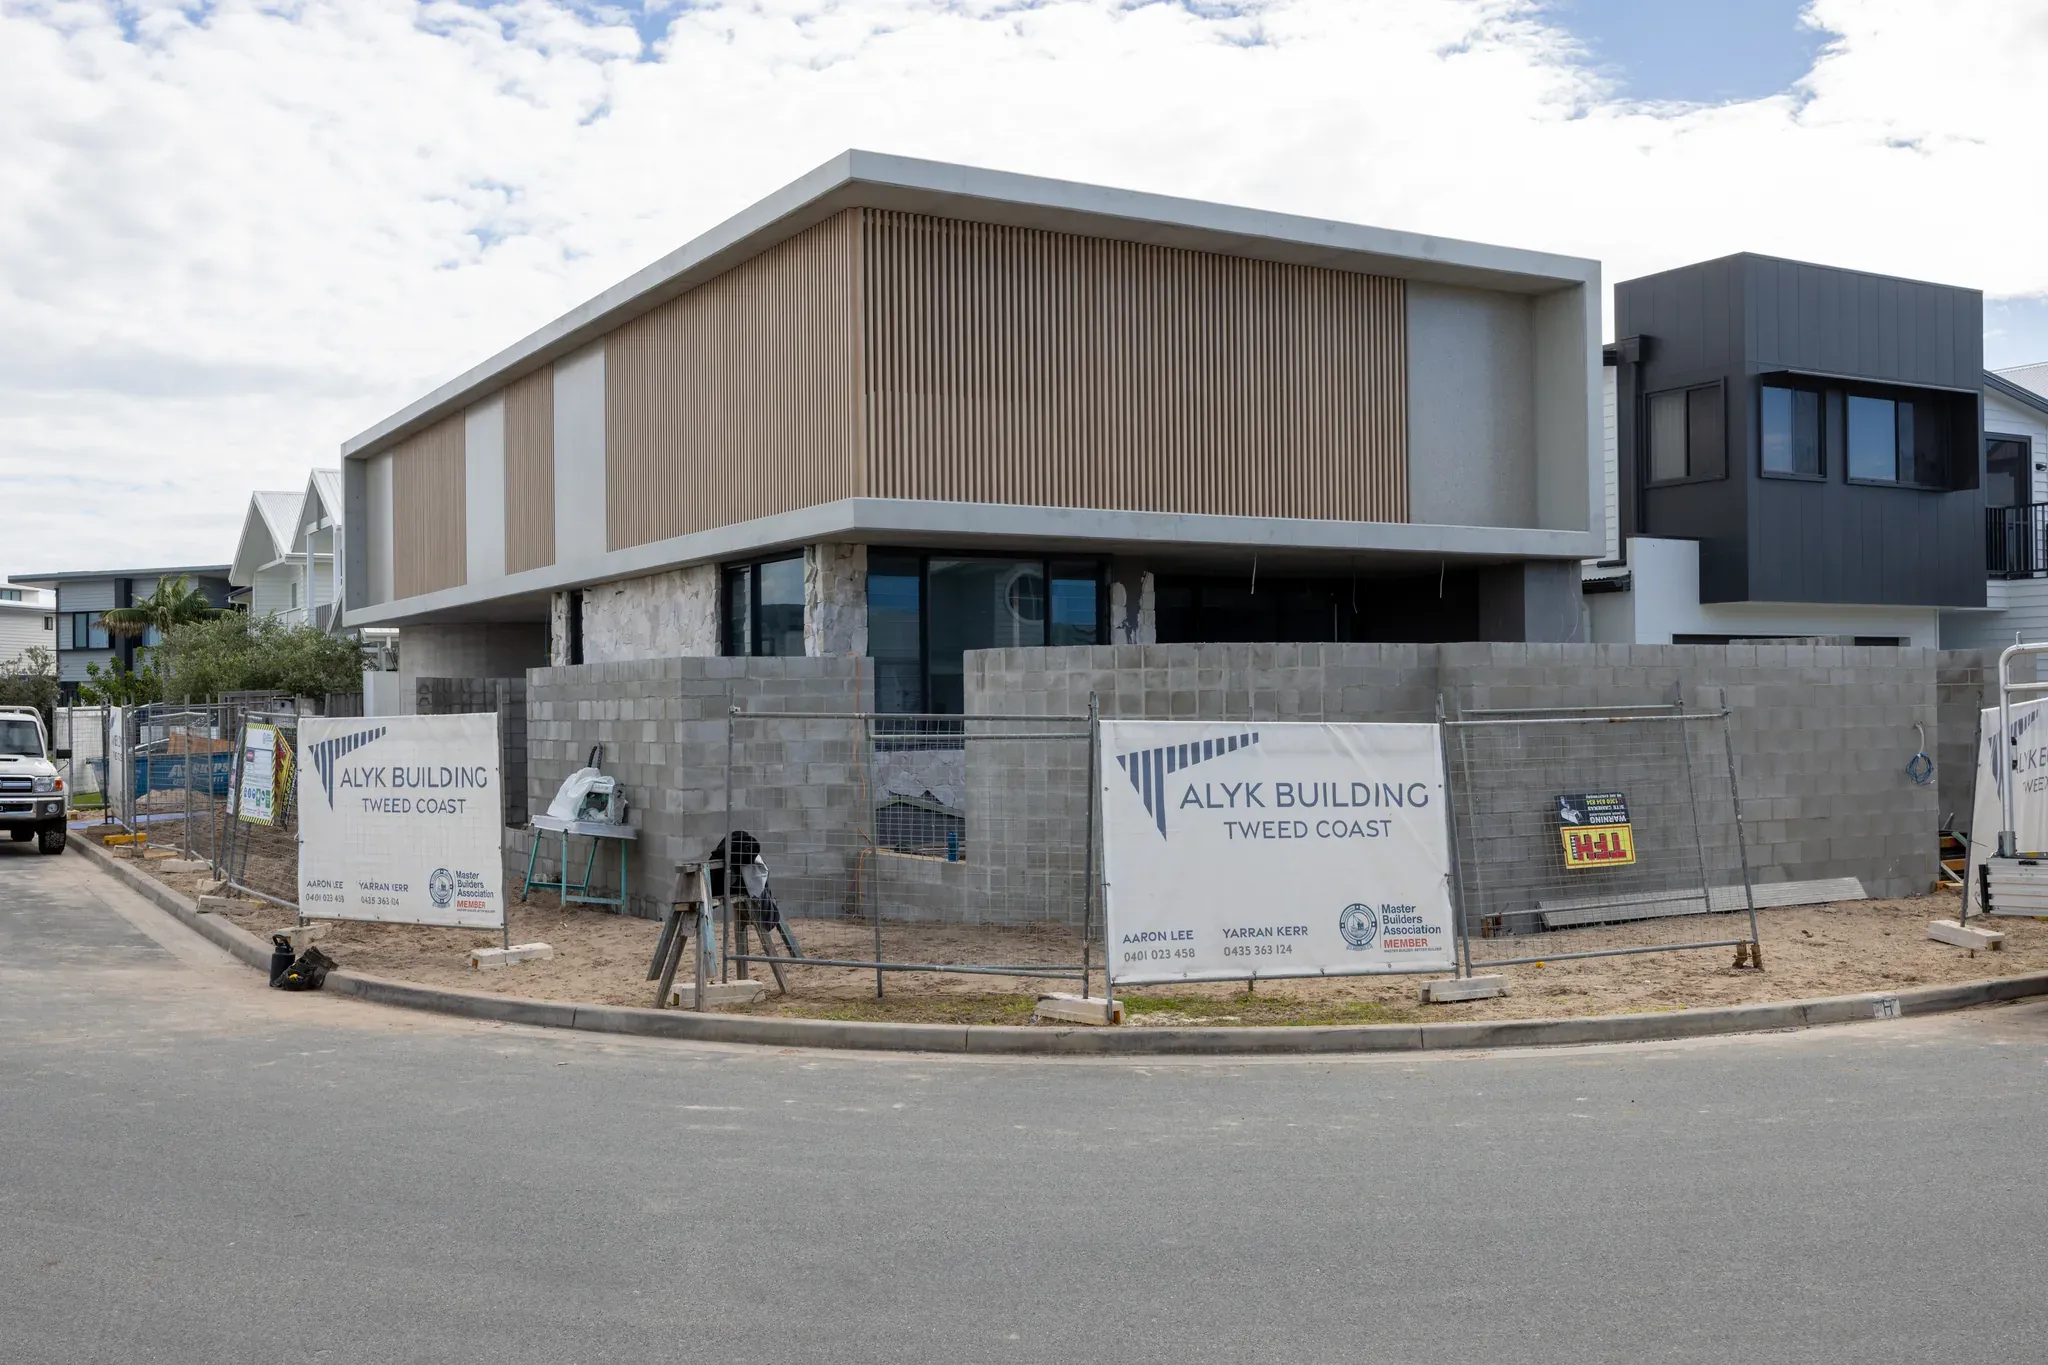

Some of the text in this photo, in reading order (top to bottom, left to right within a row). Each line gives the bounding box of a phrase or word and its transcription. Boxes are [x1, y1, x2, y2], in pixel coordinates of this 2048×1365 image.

[340, 766, 488, 788] ALYK BUILDING
[1180, 782, 1429, 809] ALYK BUILDING
[362, 798, 466, 814] TWEED COAST
[1589, 815, 1627, 824] WARNING
[1223, 819, 1392, 839] TWEED COAST
[1575, 832, 1627, 861] TFH
[456, 871, 479, 880] Master
[306, 880, 331, 888] AARON
[359, 882, 389, 891] YARRAN
[457, 880, 484, 889] Builders
[457, 889, 494, 898] Association
[377, 896, 389, 905] 363
[456, 900, 486, 909] MEMBER
[1381, 904, 1416, 914] Master
[1382, 914, 1423, 924] Builders
[1222, 925, 1309, 939] YARRAN KERR
[1383, 924, 1442, 935] Association
[1122, 930, 1194, 944] AARON LEE
[1383, 938, 1428, 949] MEMBER
[1124, 948, 1195, 962] 0401 023 458
[1223, 944, 1292, 957] 0435 363 124
